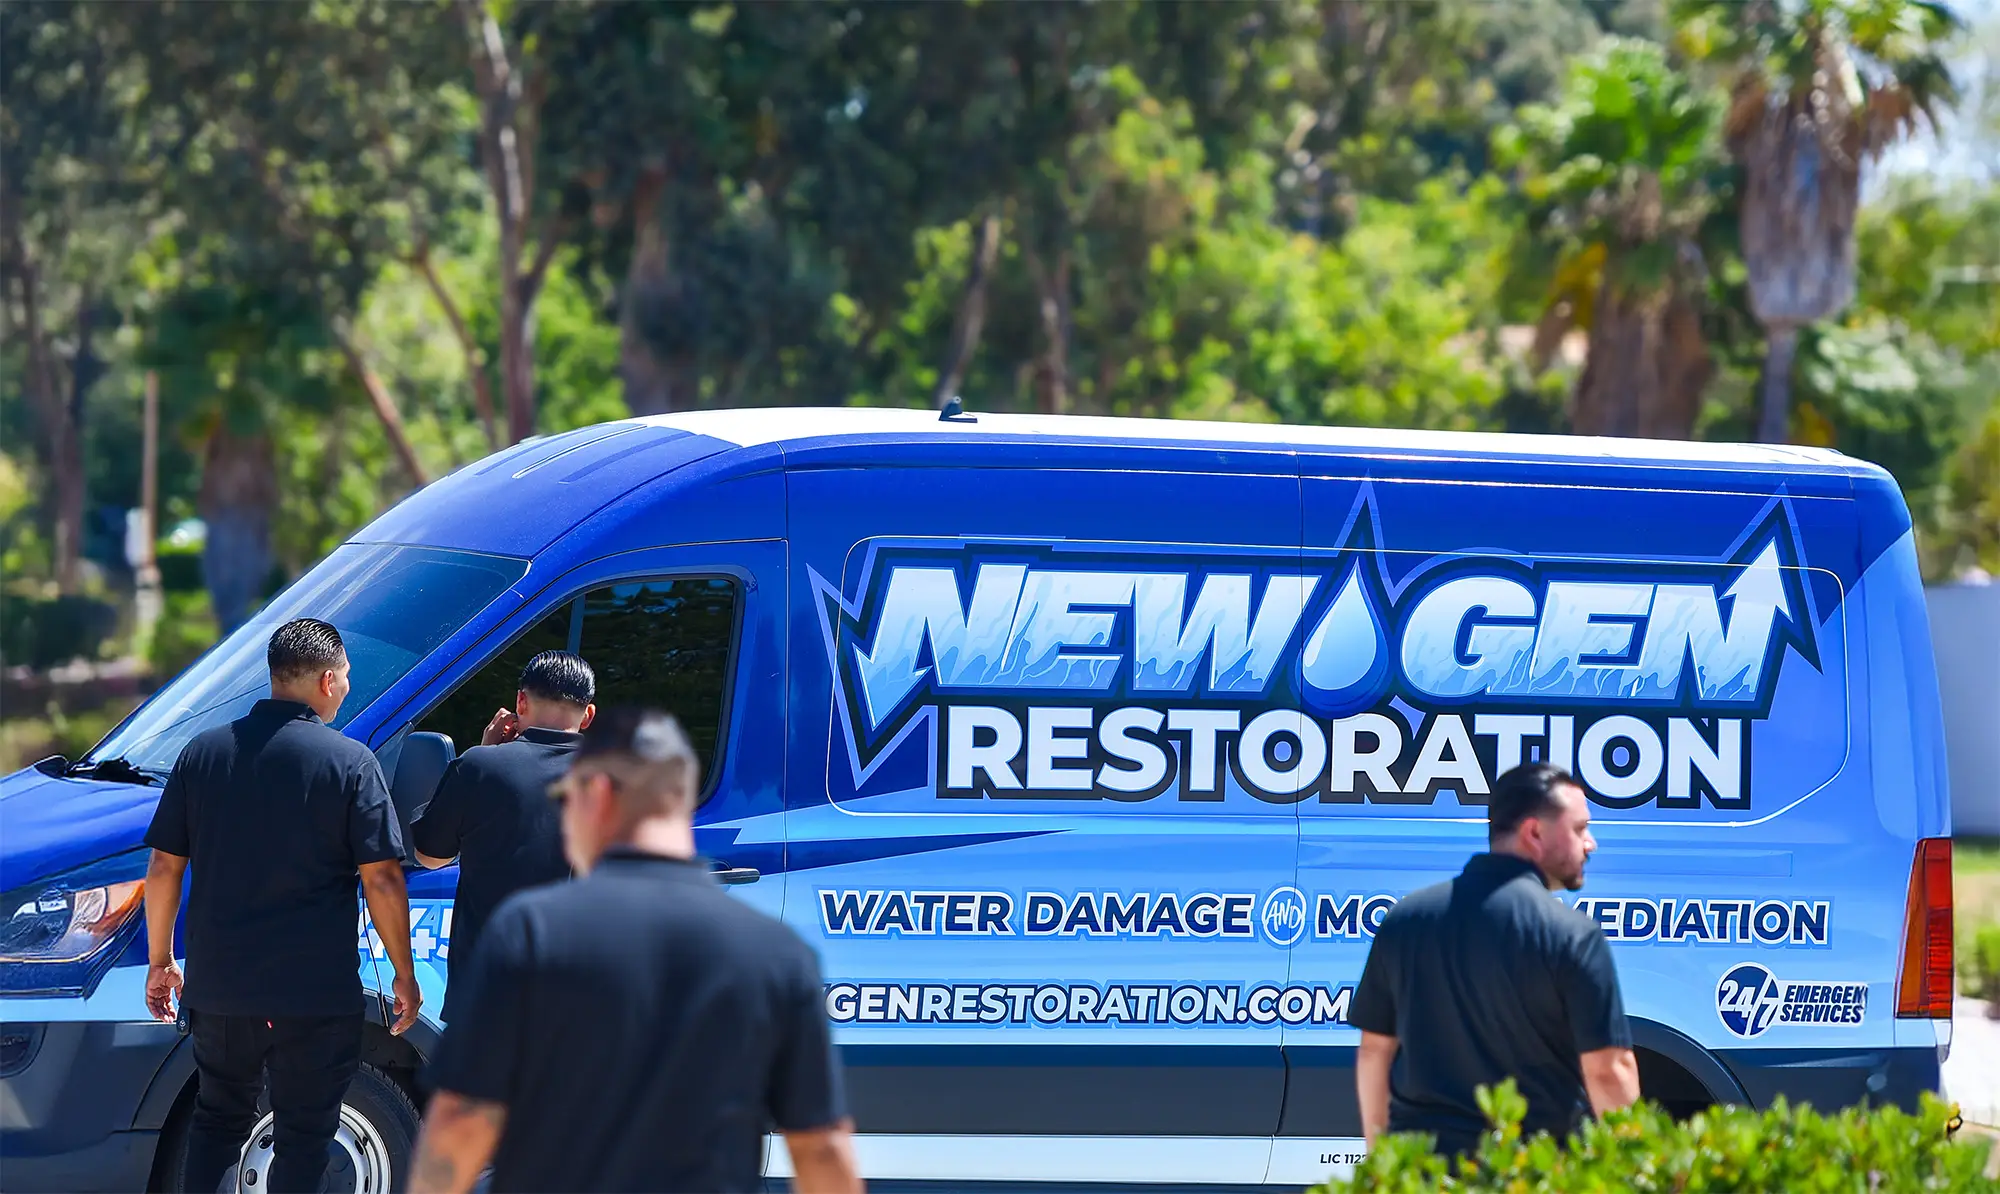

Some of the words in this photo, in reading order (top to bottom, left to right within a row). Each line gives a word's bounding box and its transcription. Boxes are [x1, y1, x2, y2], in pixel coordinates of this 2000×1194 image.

[855, 562, 1322, 731] NEW
[1401, 536, 1792, 701] GEN
[946, 705, 1742, 799] RESTORATION
[817, 889, 1014, 935] WATER
[1024, 891, 1255, 938] DAMAGE
[1264, 898, 1302, 932] AND
[1315, 894, 1399, 938] MO
[1573, 897, 1831, 944] EDIATION
[823, 982, 1354, 1025] GENRESTORATION.COM
[1719, 972, 1778, 1034] 24/7
[1780, 1004, 1864, 1024] SERVICES
[1784, 984, 1868, 1004] EMERGEN
[1319, 1153, 1341, 1164] LIC
